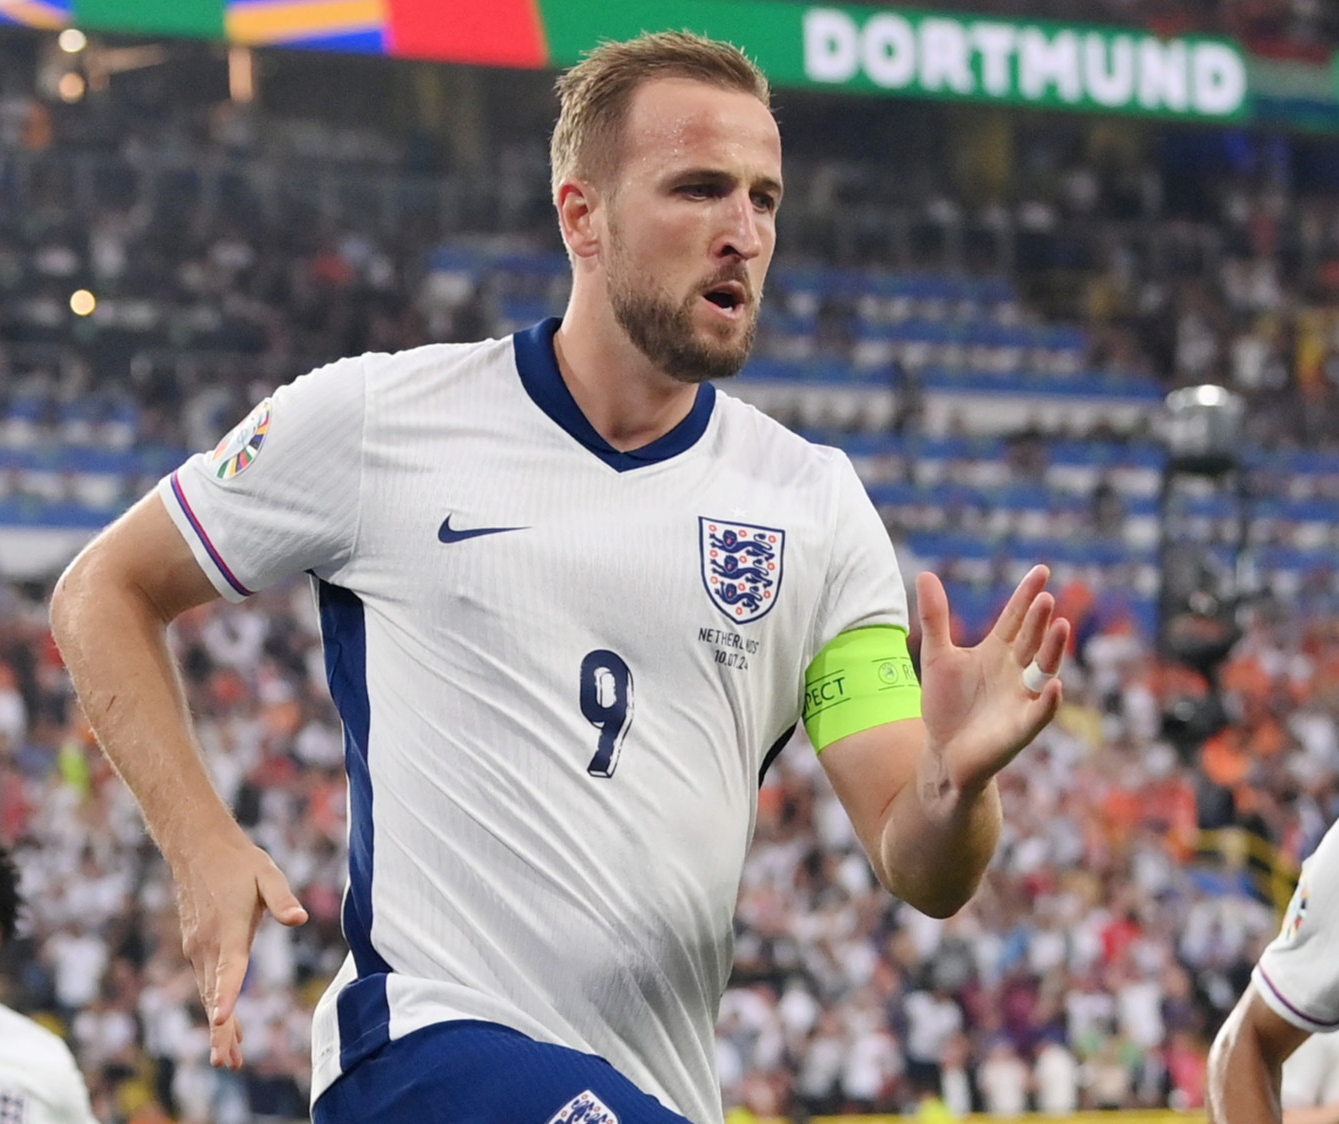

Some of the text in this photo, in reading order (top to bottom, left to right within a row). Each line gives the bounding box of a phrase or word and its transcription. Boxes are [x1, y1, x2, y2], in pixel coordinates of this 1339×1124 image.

[802, 8, 1247, 116] DORTMUND
[698, 627, 759, 655] NETHERLDS
[579, 649, 635, 779] 9
